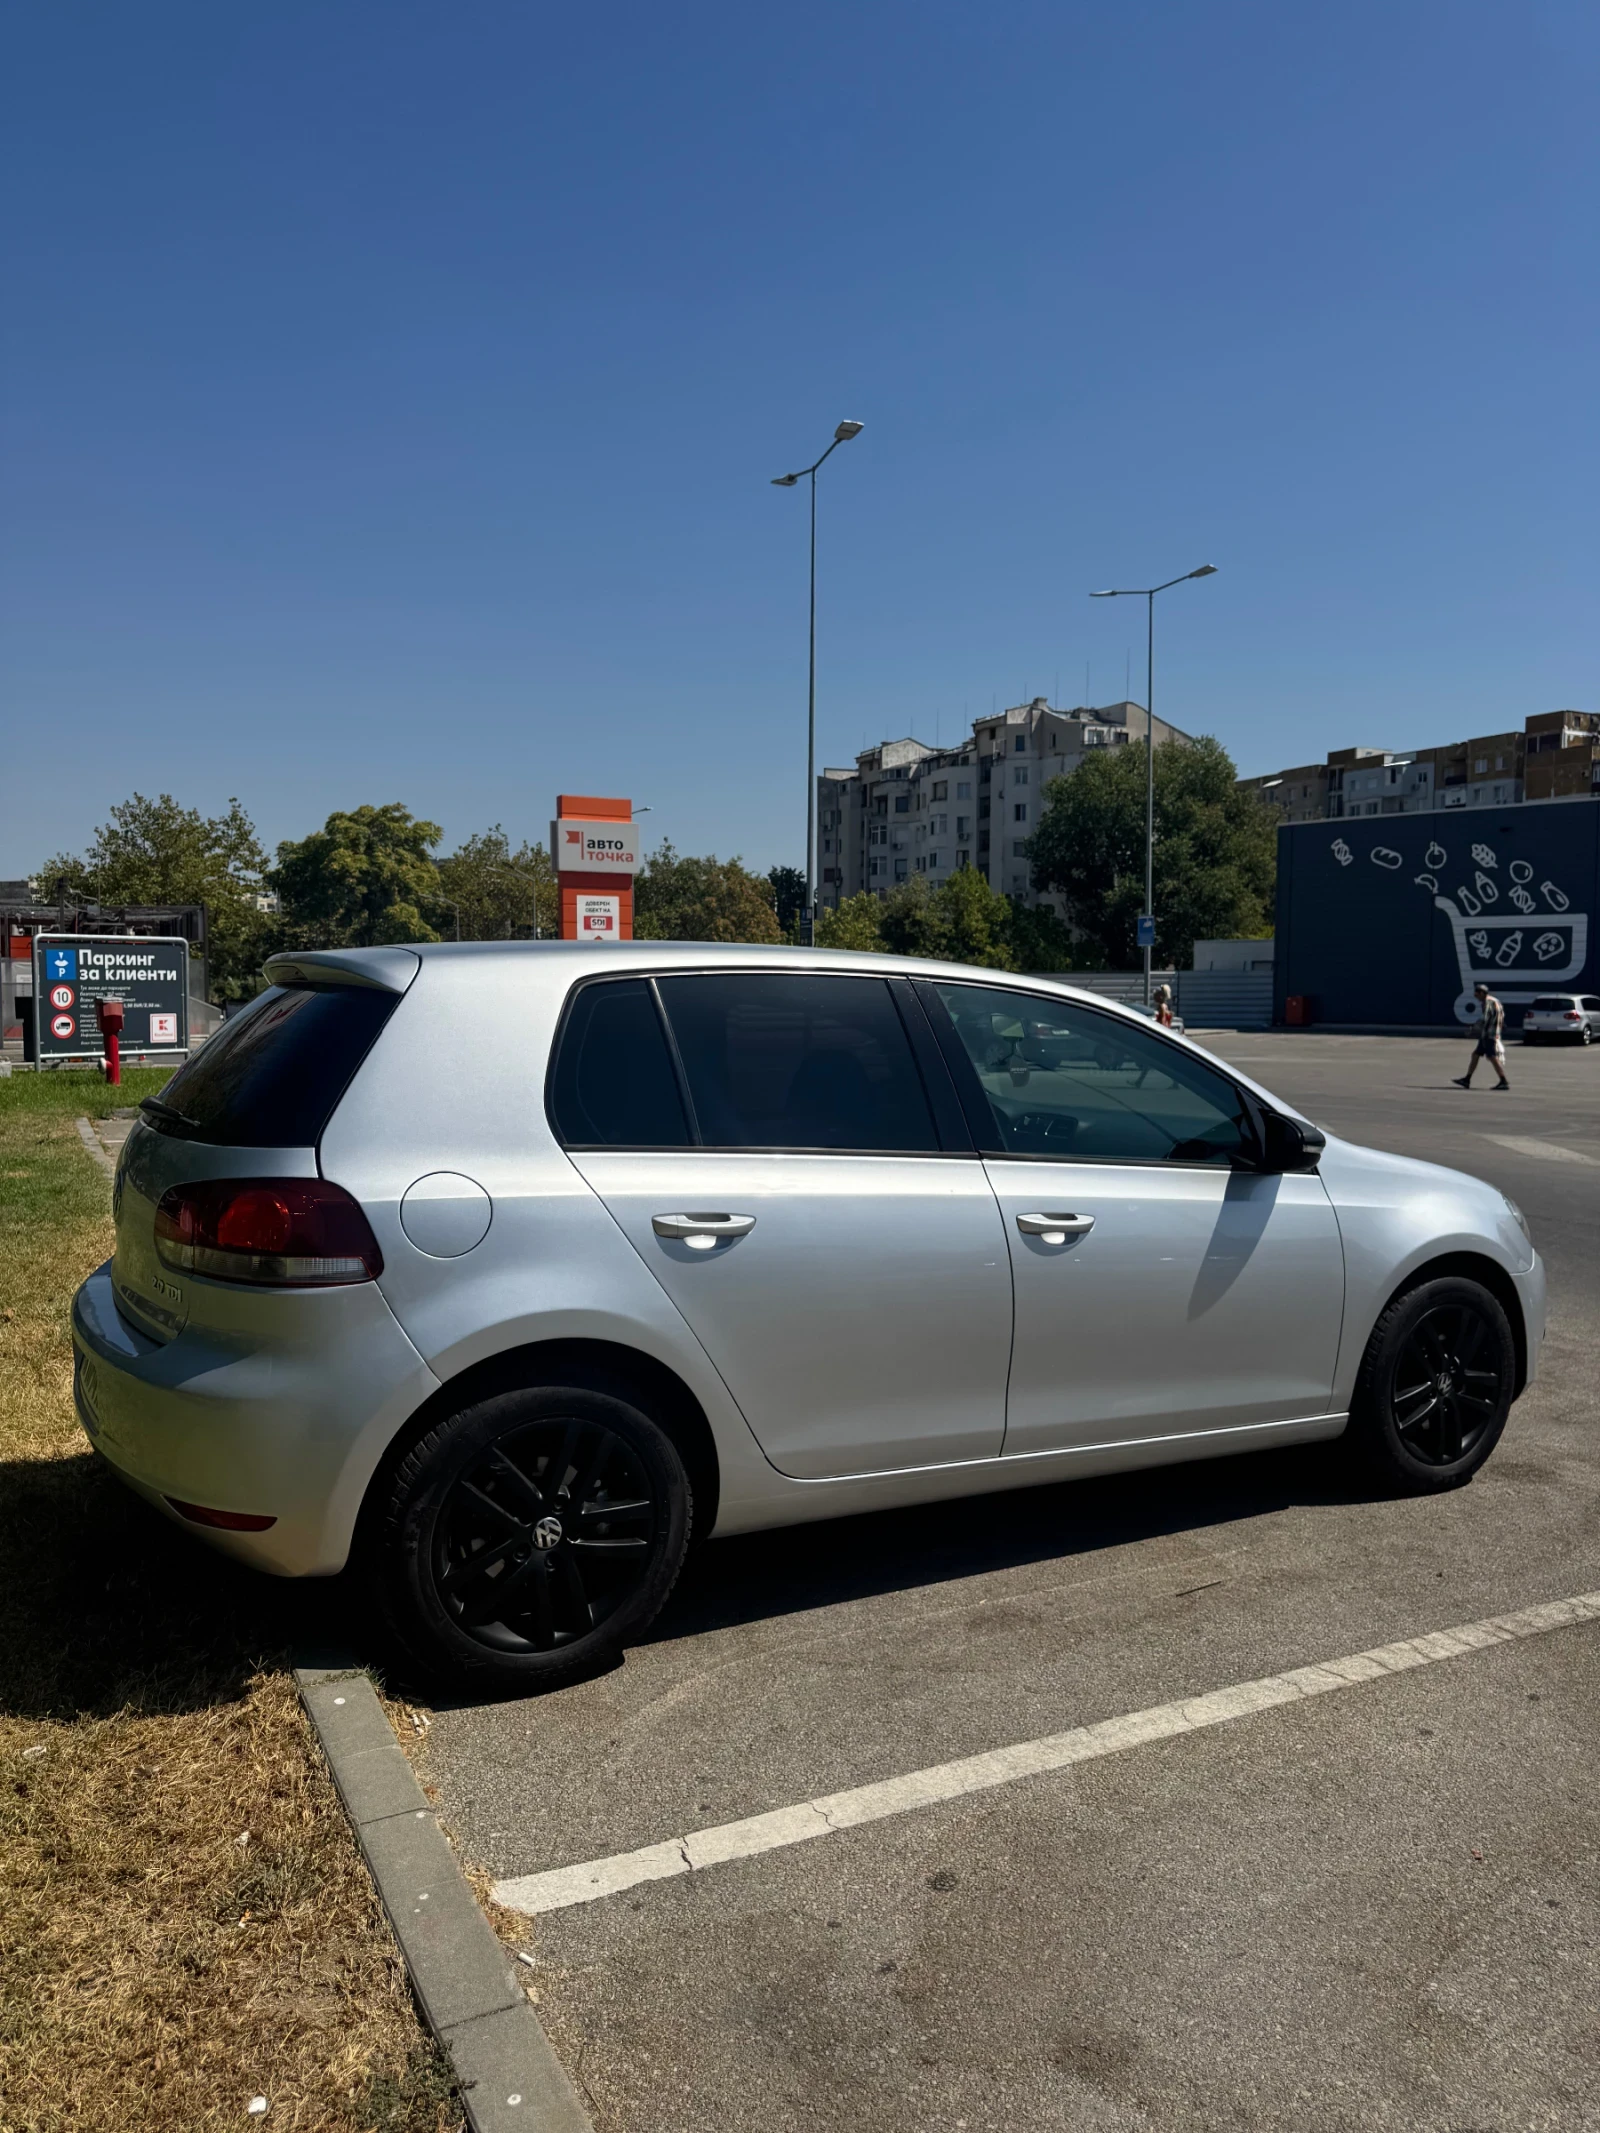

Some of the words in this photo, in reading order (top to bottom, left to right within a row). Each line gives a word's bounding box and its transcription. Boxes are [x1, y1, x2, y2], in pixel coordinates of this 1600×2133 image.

[587, 839, 624, 850] авто
[587, 850, 634, 863] точка
[79, 949, 155, 968] Паркинг
[80, 969, 100, 981] за
[105, 968, 177, 981] клиенти
[56, 991, 69, 1003] 10
[166, 1282, 183, 1303] TDI
